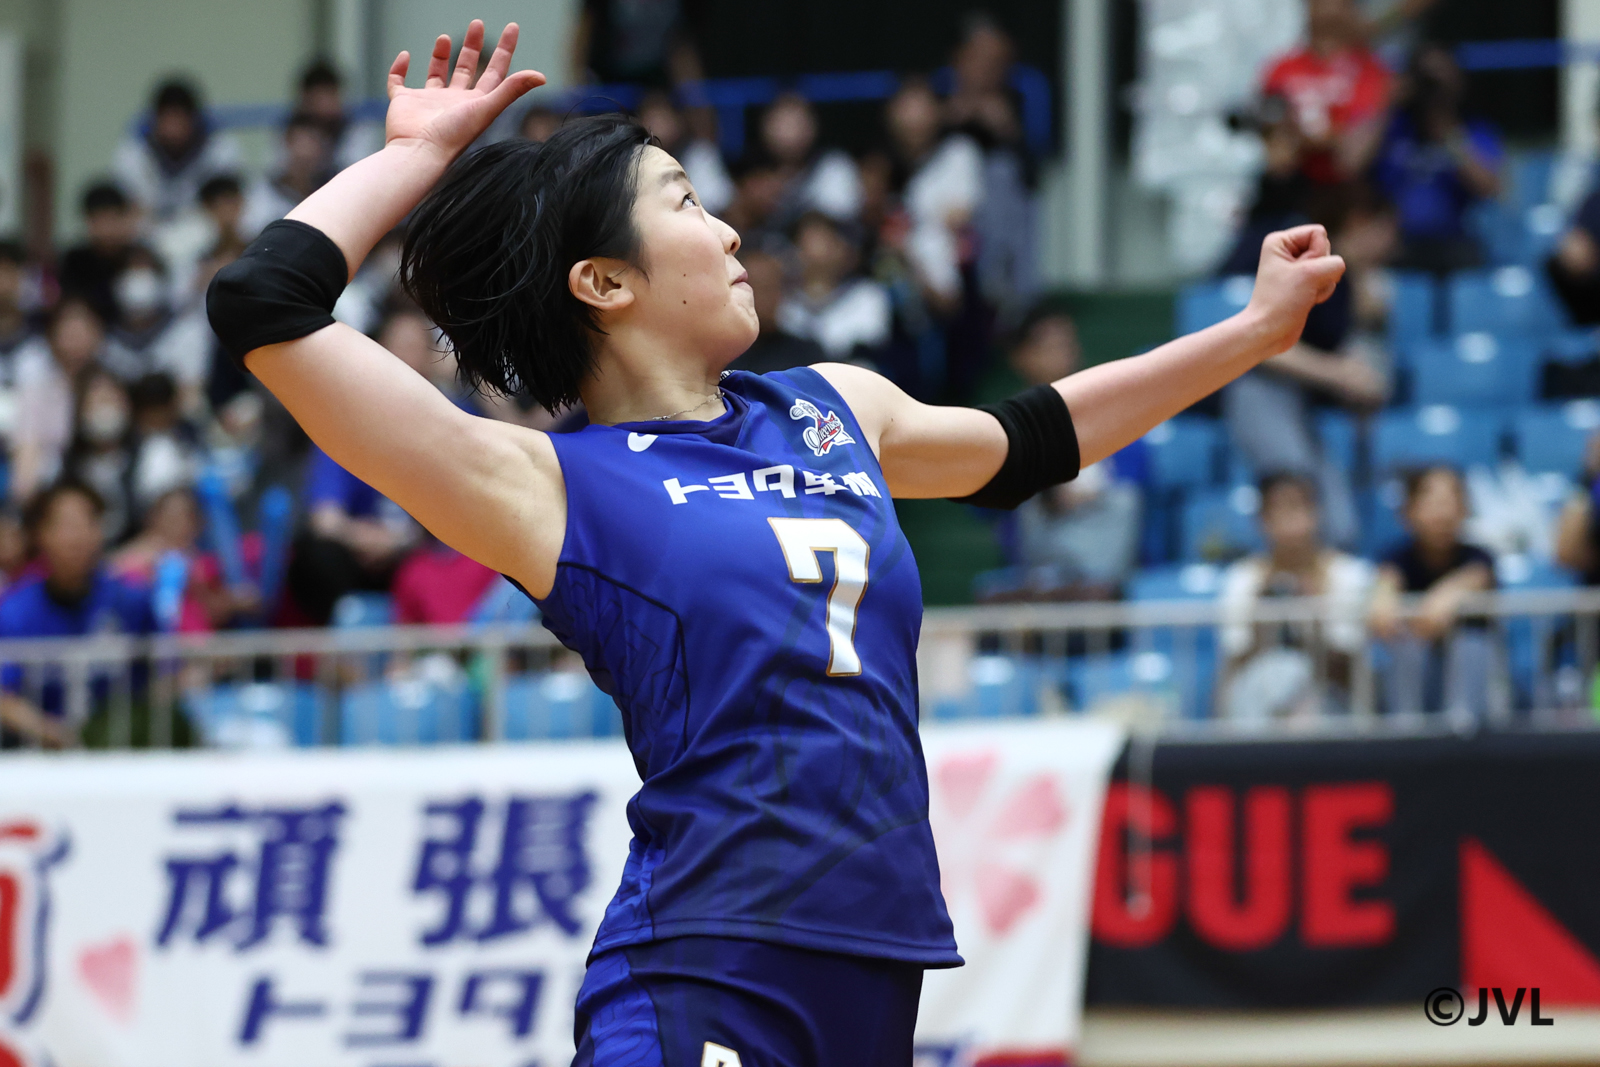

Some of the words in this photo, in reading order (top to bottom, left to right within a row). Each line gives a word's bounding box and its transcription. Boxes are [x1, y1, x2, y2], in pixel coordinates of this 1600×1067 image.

[767, 517, 870, 677] 7
[237, 967, 580, 1048] トヨタ
